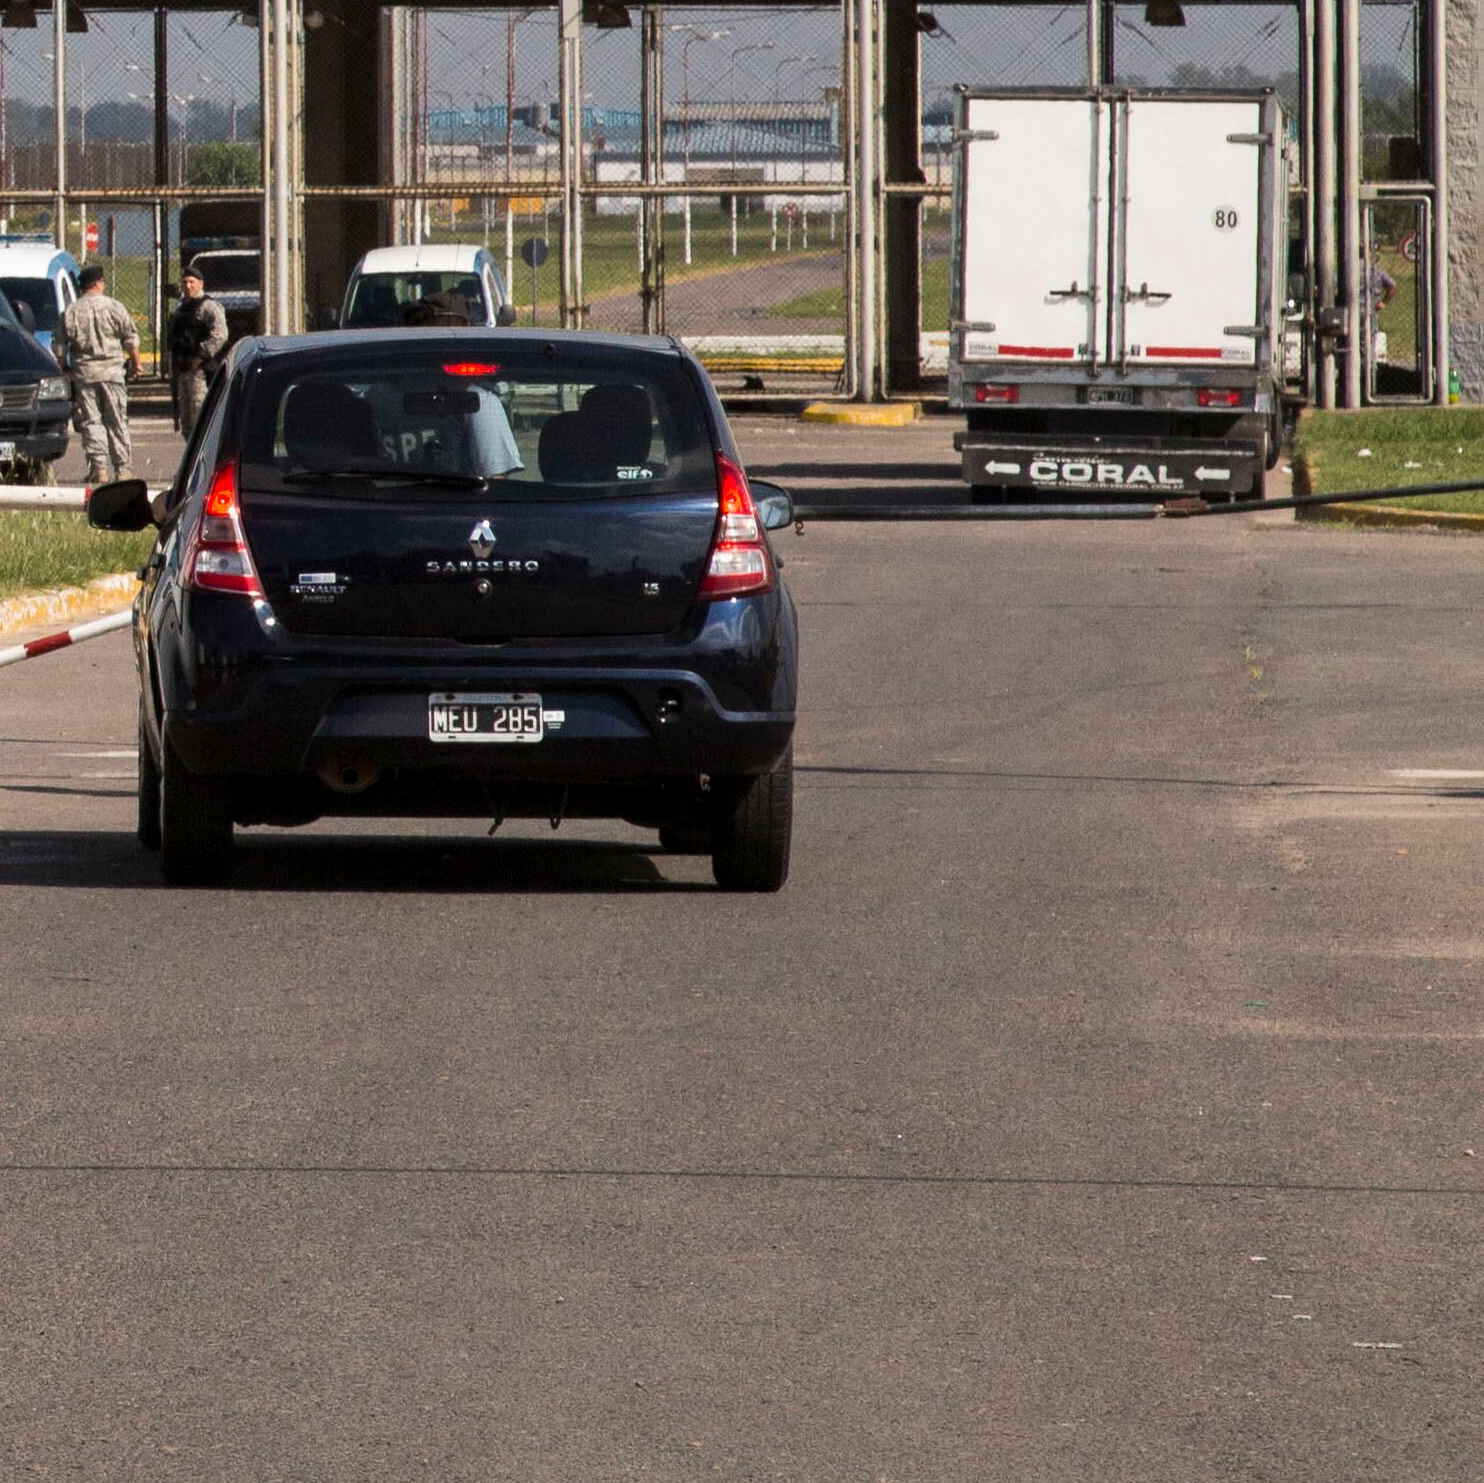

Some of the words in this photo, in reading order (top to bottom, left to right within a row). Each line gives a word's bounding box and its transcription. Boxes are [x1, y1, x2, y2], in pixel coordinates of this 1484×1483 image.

[1215, 210, 1237, 228] 80
[1029, 461, 1185, 485] CORAL
[426, 560, 539, 573] SANDERO
[433, 705, 478, 733] MEU
[493, 705, 538, 733] 285
